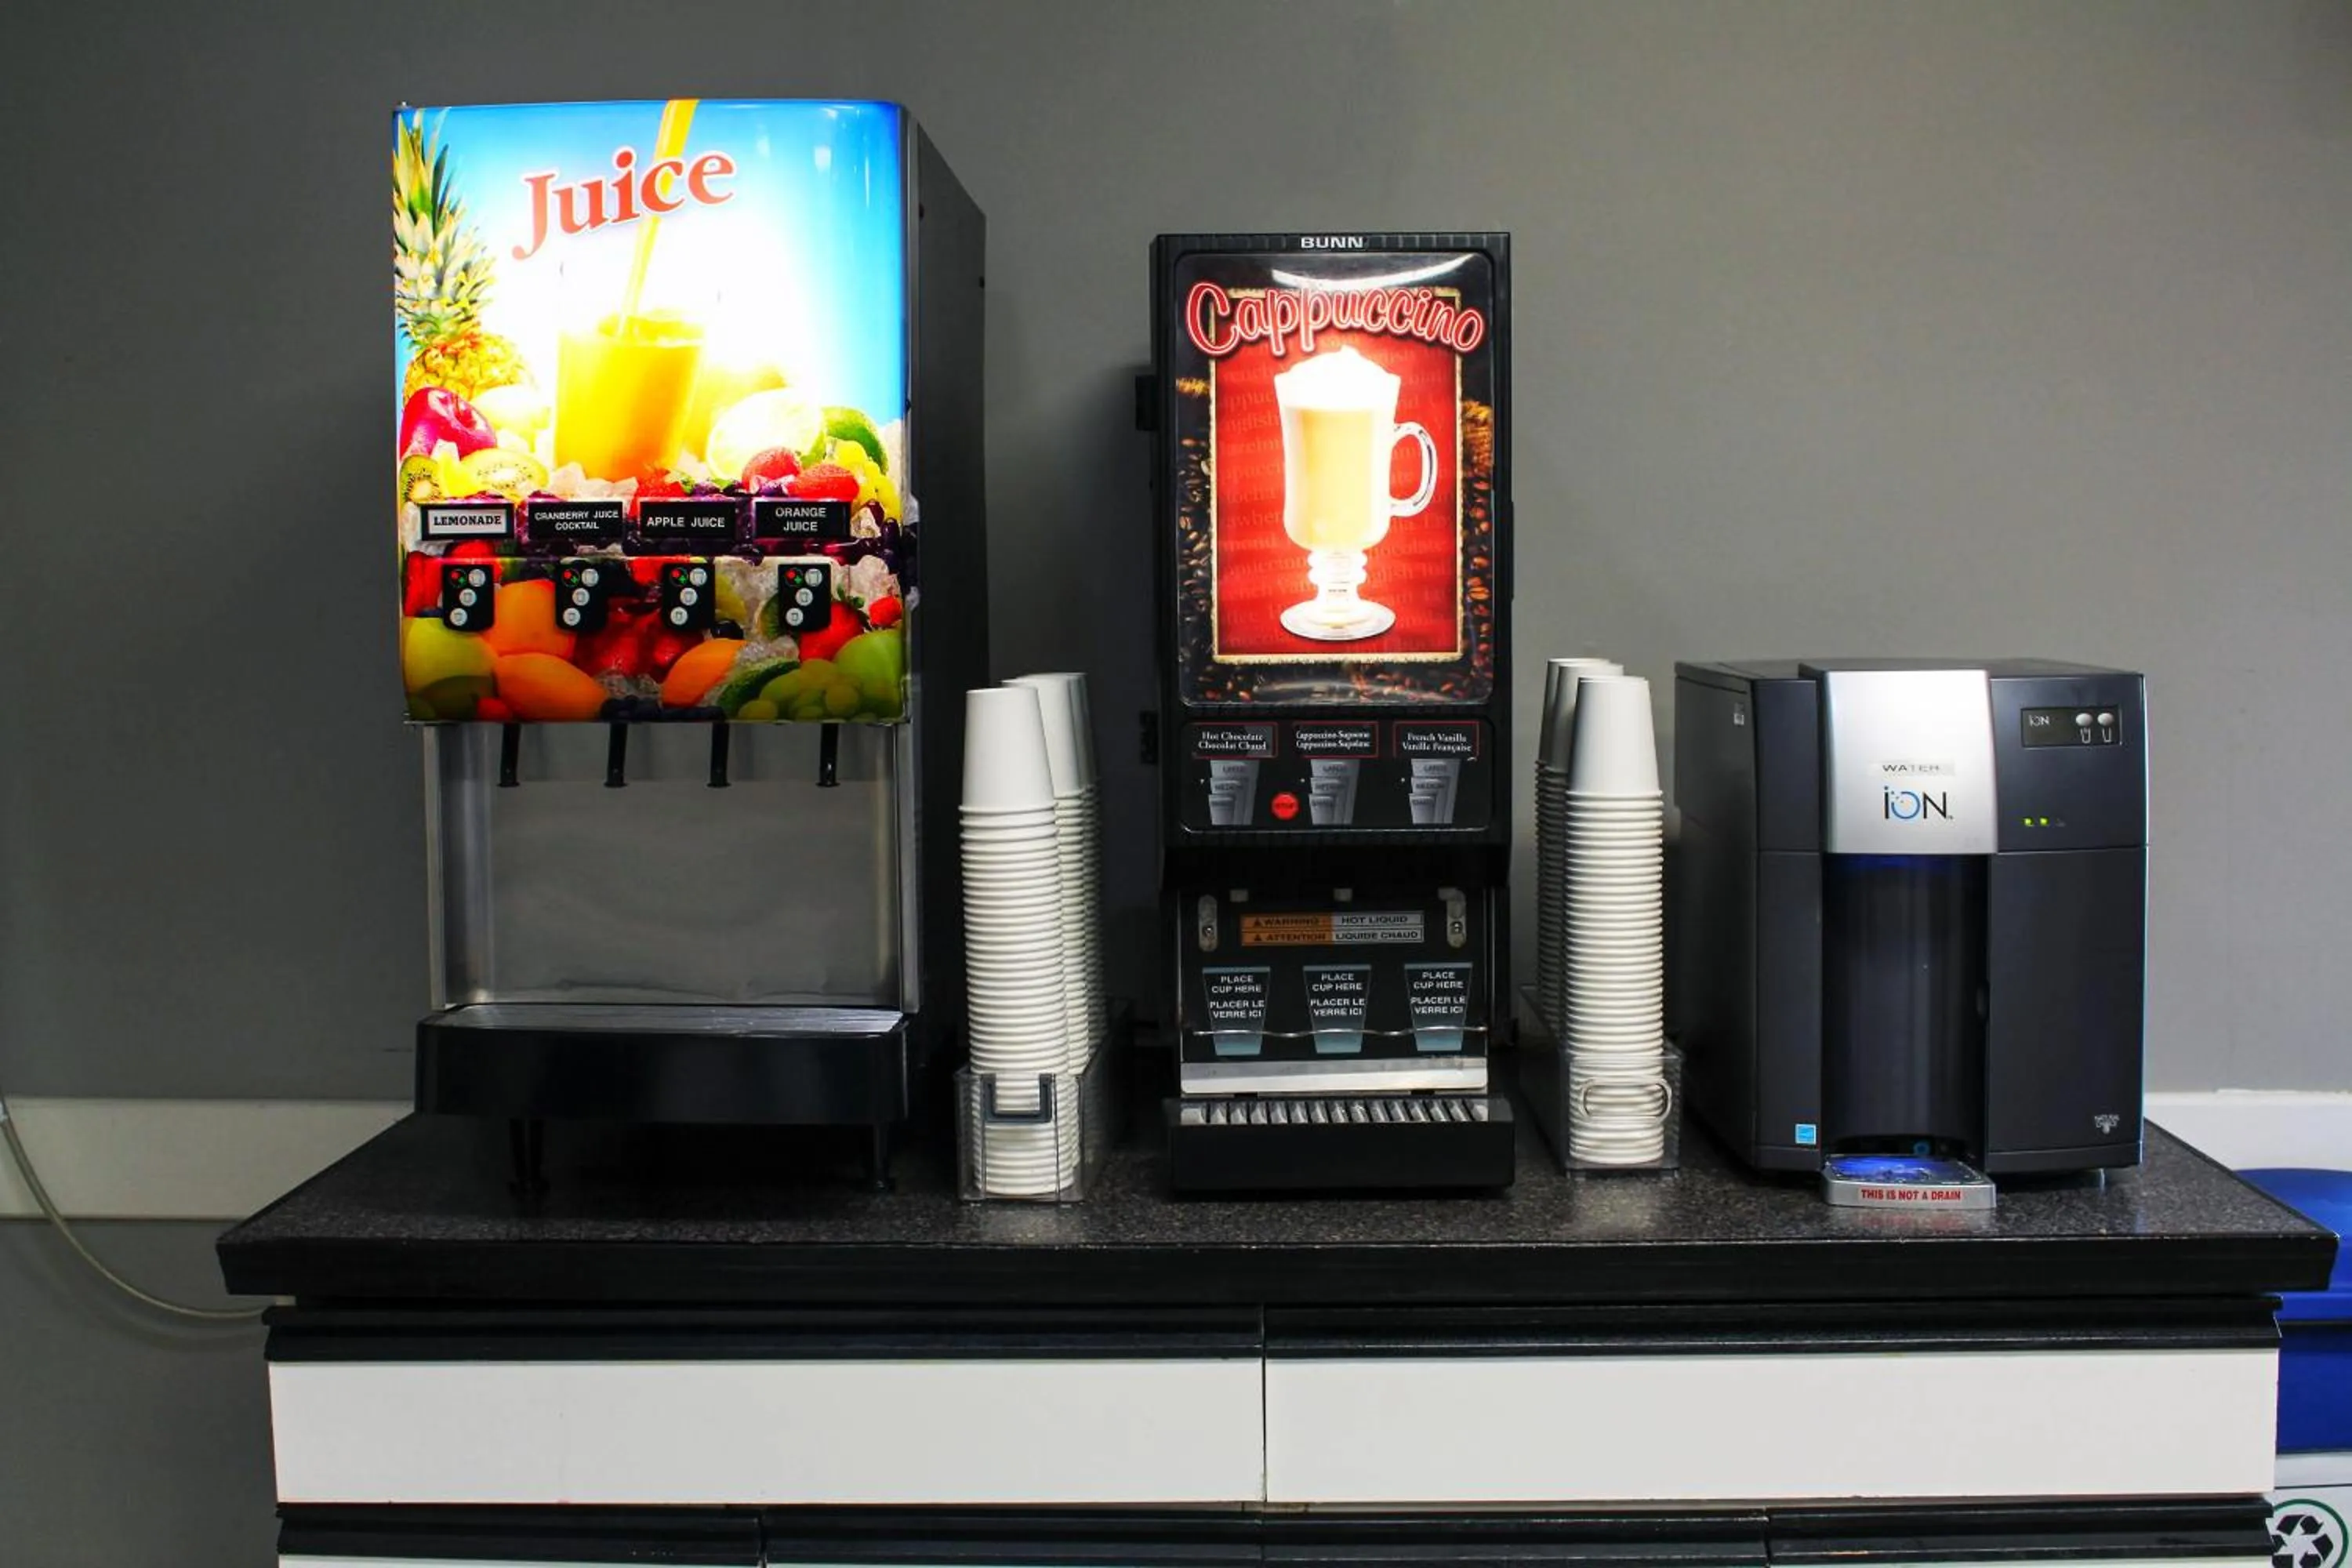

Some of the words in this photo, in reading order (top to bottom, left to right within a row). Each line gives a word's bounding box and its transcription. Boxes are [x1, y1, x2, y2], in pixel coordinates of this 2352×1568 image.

[512, 149, 735, 260] Juice
[1301, 236, 1363, 249] BUNN
[1185, 281, 1485, 357] Cappuccino
[535, 510, 589, 521] CRANBERRY
[593, 510, 619, 519] JUICE
[775, 507, 826, 517] ORANGE
[434, 514, 502, 526] LEMONADE
[646, 517, 685, 528] APPLE
[691, 517, 725, 528] JUICE
[555, 521, 600, 531] COCKTAIL
[784, 521, 818, 532] JUICE
[1265, 917, 1319, 927] WARNING
[1341, 916, 1366, 924] HOT
[1369, 915, 1408, 924] LIQUID
[1268, 932, 1325, 941] ATTENTION
[1335, 931, 1377, 940] LIQUIDE
[1381, 931, 1418, 939] CHAUD
[1235, 984, 1261, 993] HERE
[1312, 983, 1333, 992] CUP
[1335, 982, 1363, 991] HERE
[1413, 981, 1434, 989] CUP
[1210, 1000, 1249, 1009] PLACER
[1310, 998, 1349, 1007] PLACER
[1213, 1010, 1247, 1018] VERRE
[1313, 1008, 1347, 1017] VERRE
[1861, 1189, 1884, 1200] THIS
[1886, 1191, 1896, 1200] IS
[1898, 1191, 1919, 1200] NOT
[1931, 1191, 1961, 1200] DRAIN
